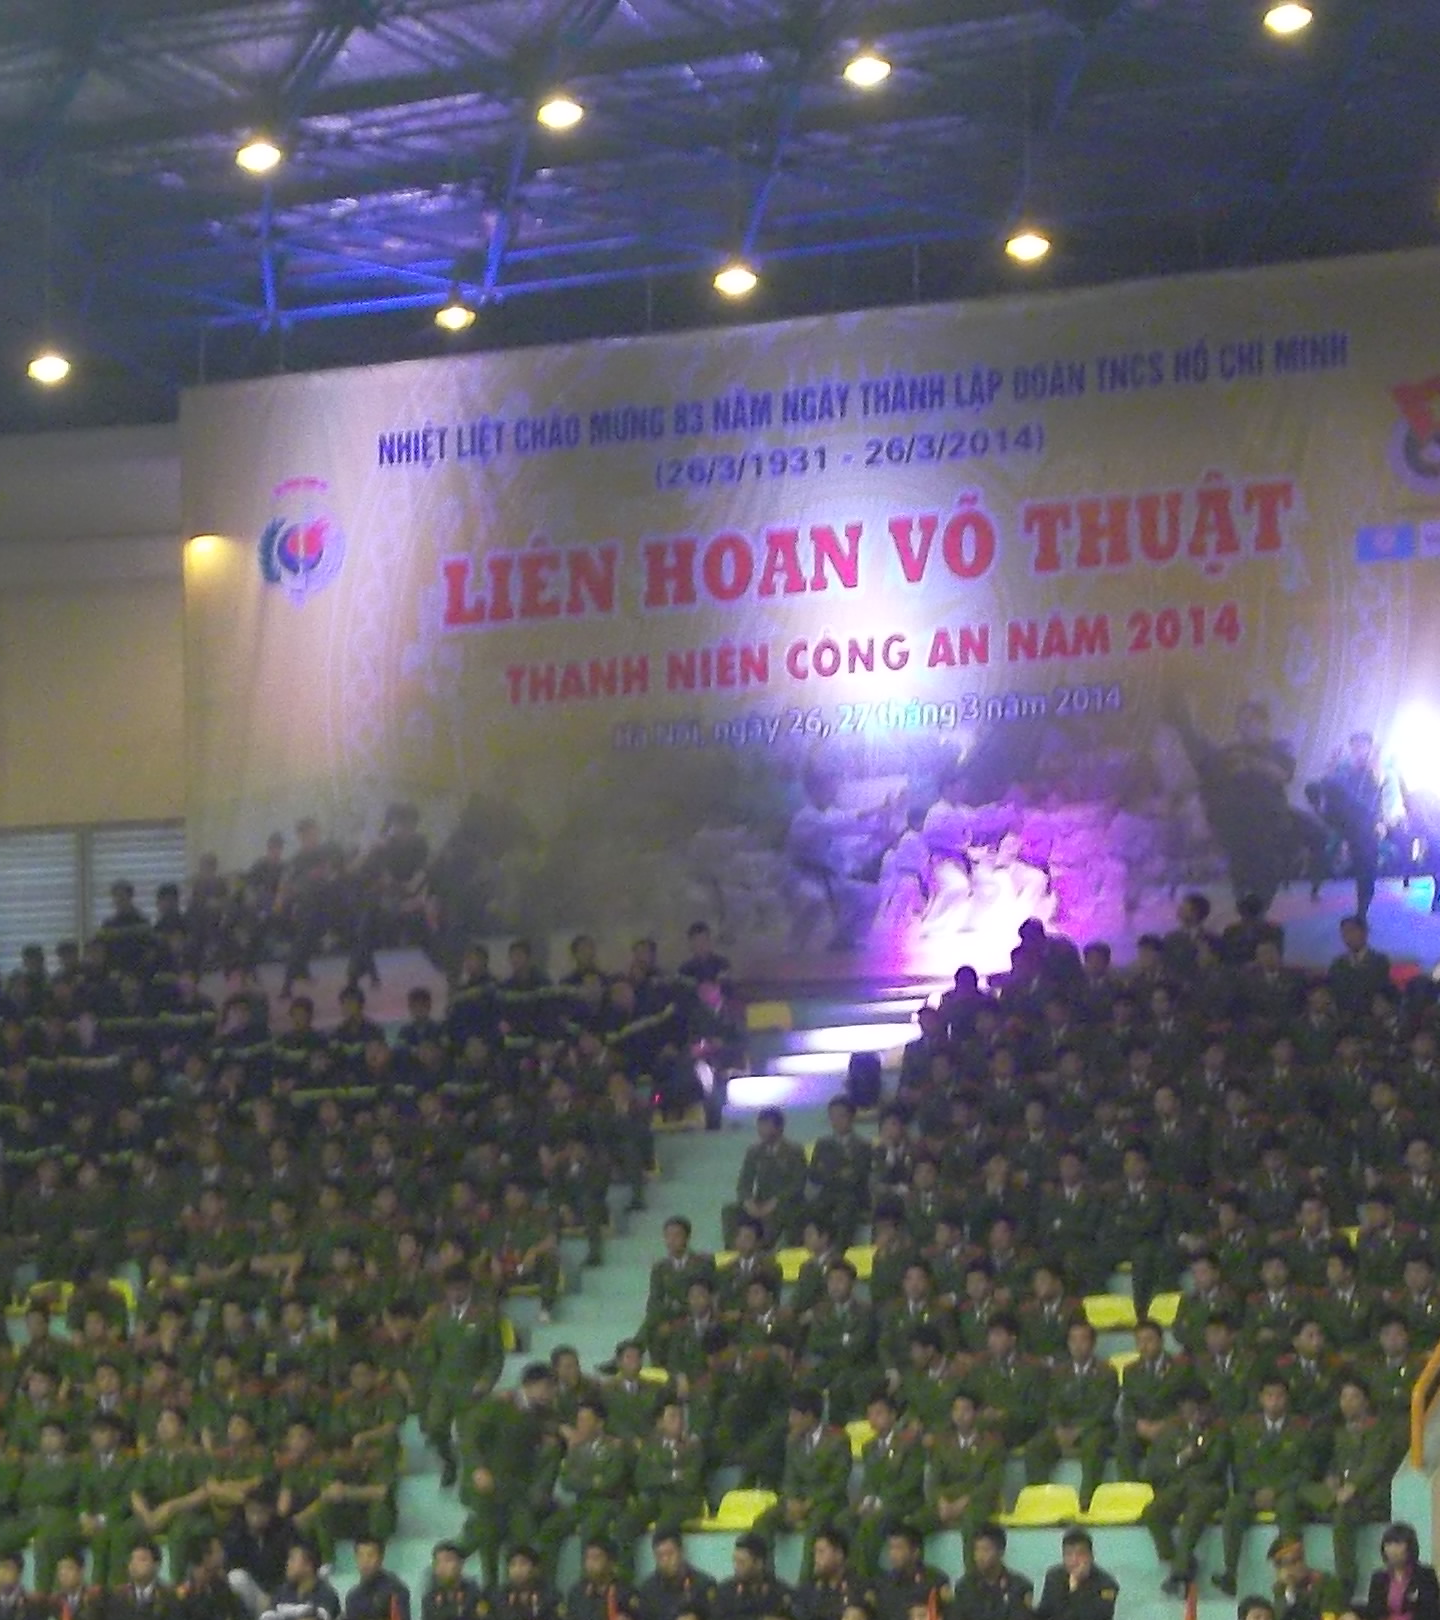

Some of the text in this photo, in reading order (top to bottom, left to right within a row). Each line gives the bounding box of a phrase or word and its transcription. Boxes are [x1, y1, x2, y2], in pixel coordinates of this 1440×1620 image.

[378, 423, 449, 470] NHIỆT
[456, 413, 505, 464] LIỆT
[674, 402, 704, 436] 83
[1096, 351, 1163, 392] TNCS
[1274, 332, 1348, 373] MINH
[656, 444, 826, 489] (26/3/1931
[865, 423, 1046, 467] 26/3/2014)
[443, 533, 618, 627] LIÊN
[643, 522, 862, 608] HOAN
[1023, 470, 1294, 574] THUẬT
[506, 653, 649, 705] THANH
[786, 626, 910, 681] CÔNG
[927, 622, 990, 668] AN
[1127, 600, 1240, 653] 2014
[961, 690, 980, 721] 3
[1057, 684, 1121, 713] 2014
